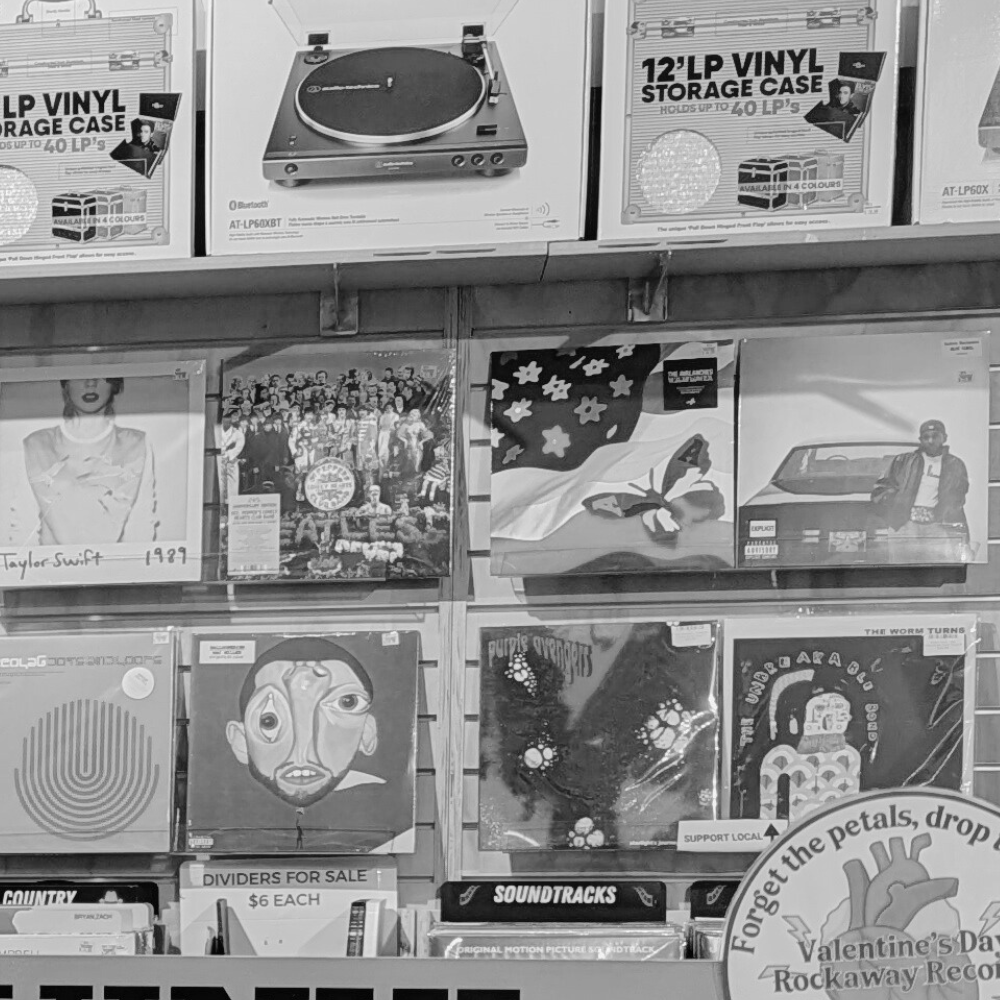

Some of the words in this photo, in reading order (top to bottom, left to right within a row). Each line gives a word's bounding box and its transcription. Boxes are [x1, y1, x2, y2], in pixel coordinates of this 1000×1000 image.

[732, 48, 824, 78] VINYL
[641, 80, 753, 102] STORAGE
[759, 75, 823, 96] CASE
[42, 89, 126, 116] VINYL
[660, 104, 697, 115] HOLDS
[699, 103, 713, 112] UP
[714, 101, 729, 112] TO
[731, 100, 757, 116] 40
[69, 115, 125, 134] CASE
[13, 140, 27, 149] UP
[28, 140, 42, 149] TO
[43, 138, 67, 153] 40
[941, 185, 989, 197] AT-LP60X
[229, 217, 282, 230] AT-LP60XBT
[54, 549, 105, 568] Swift
[145, 546, 188, 566] 1989
[865, 628, 886, 636] THE
[890, 627, 924, 635] WORM
[683, 833, 728, 844] SUPPORT
[731, 831, 764, 842] LOCAL
[203, 872, 281, 886] DIVIDERS
[286, 871, 320, 884] FOR
[325, 869, 368, 883] SALE
[731, 866, 789, 955] Forget
[781, 836, 827, 874] the
[827, 804, 920, 851] petals,
[925, 805, 991, 847] drop
[2, 890, 78, 905] COUNTRY
[248, 893, 269, 909] $6
[273, 893, 321, 907] EACH
[493, 885, 617, 904] SOUNDTRACKS
[455, 945, 503, 955] ORIGINAL
[504, 945, 545, 955] MOTION
[546, 945, 587, 954] PICTURE
[797, 931, 954, 964] Valentine's
[773, 964, 919, 994] Rockaway
